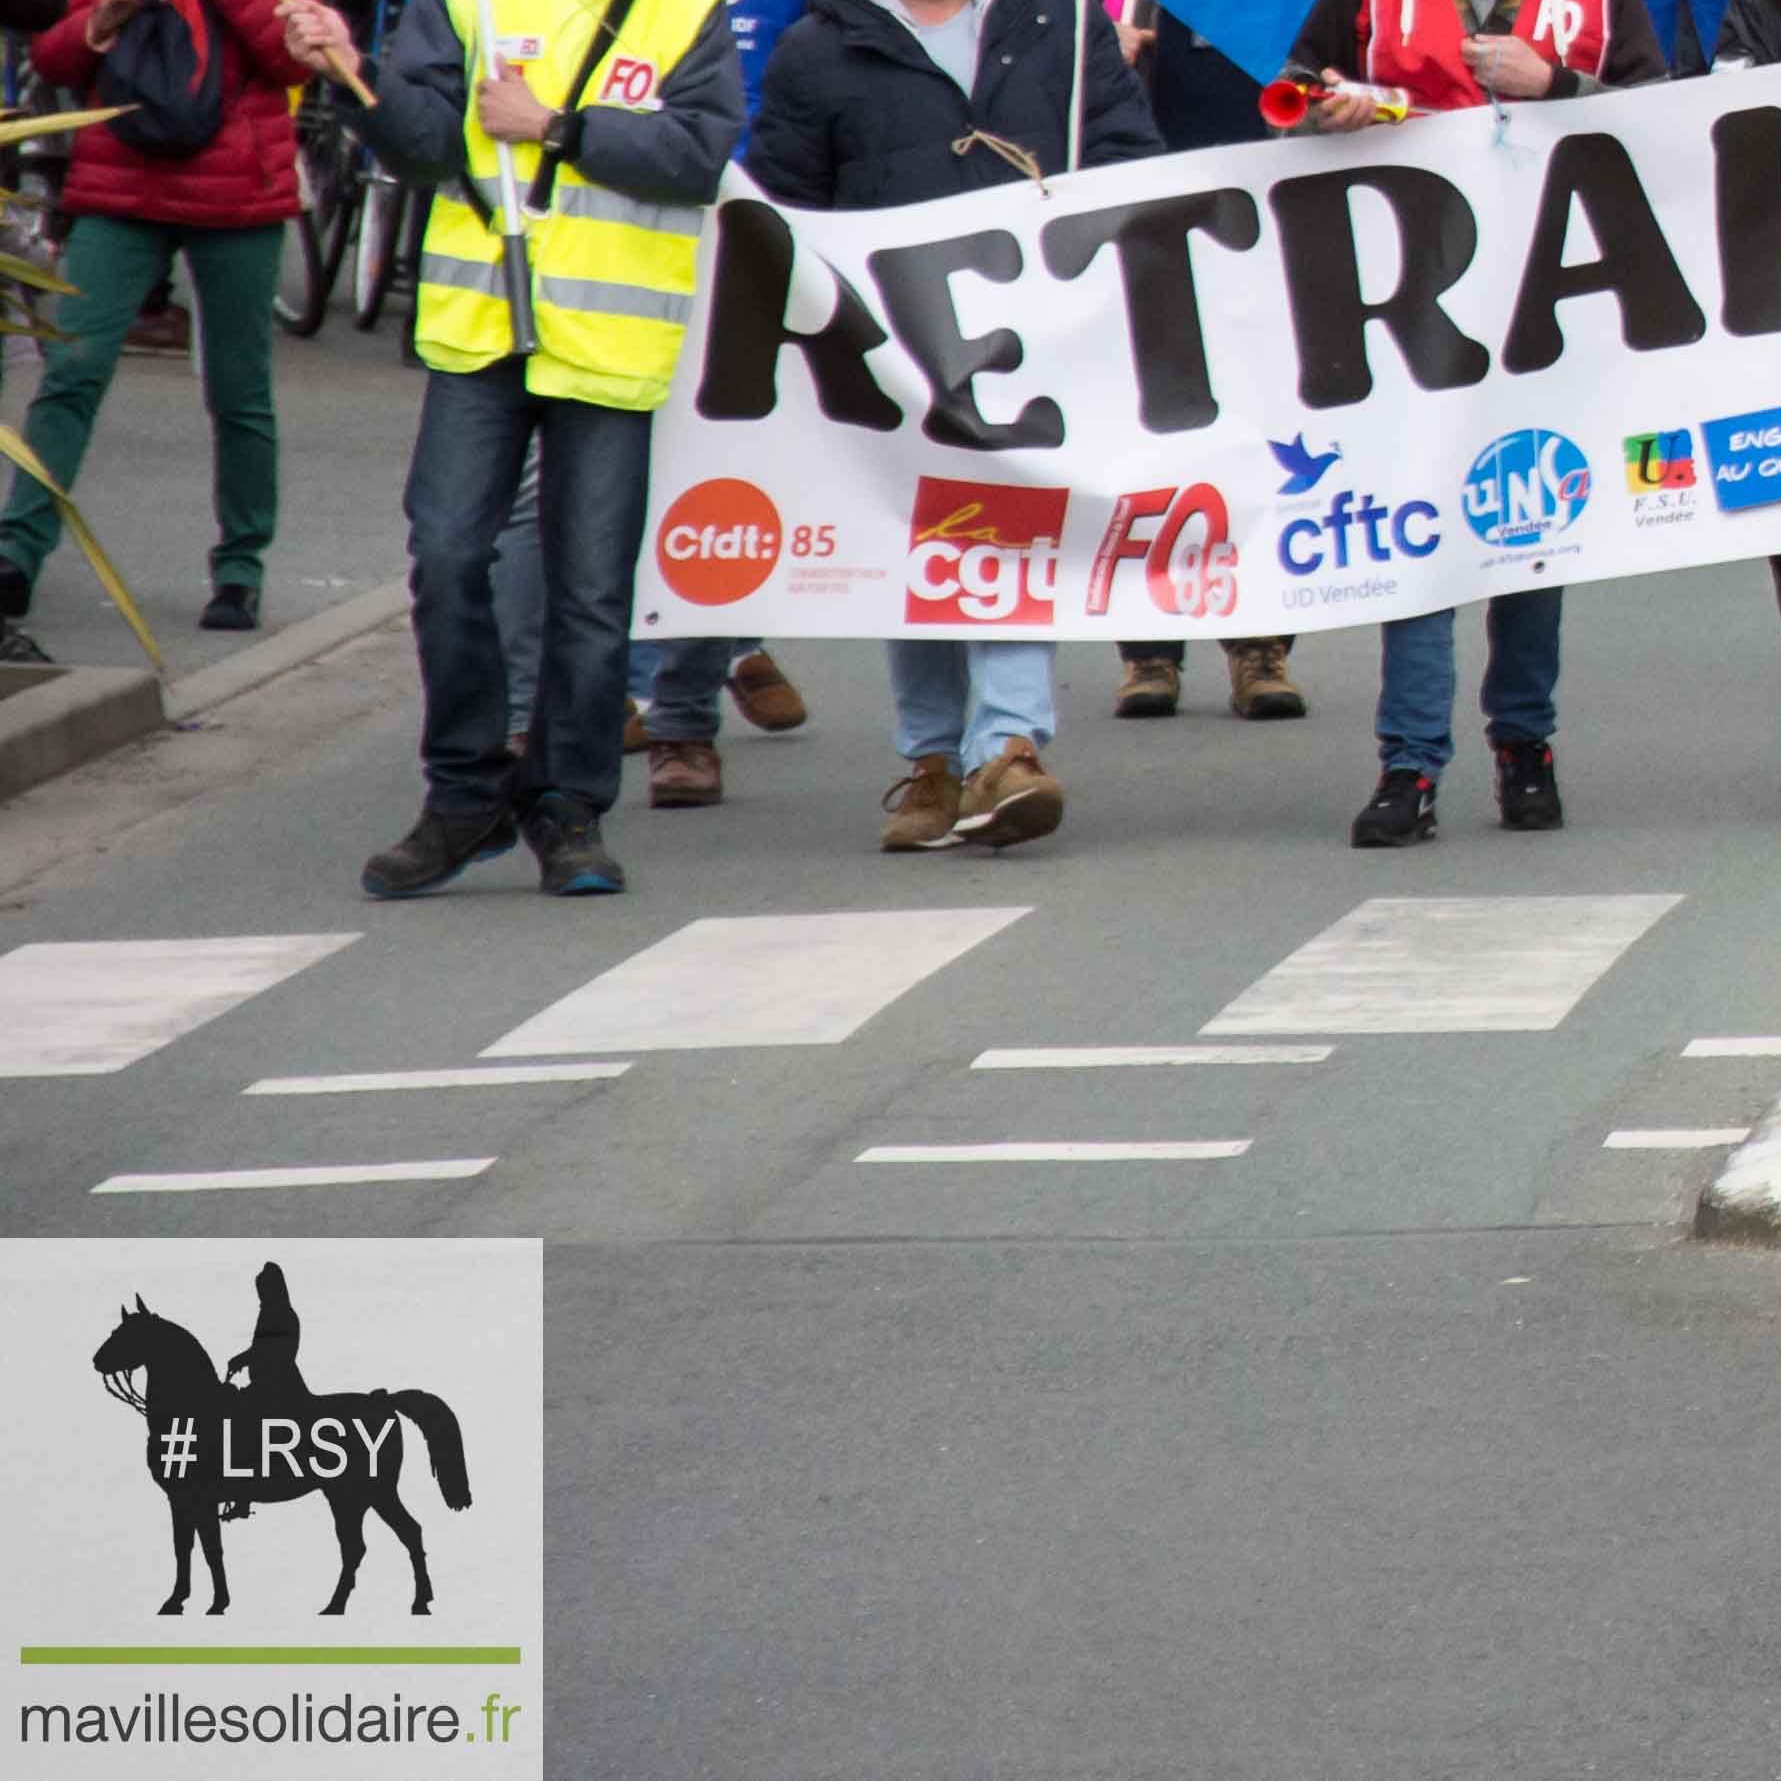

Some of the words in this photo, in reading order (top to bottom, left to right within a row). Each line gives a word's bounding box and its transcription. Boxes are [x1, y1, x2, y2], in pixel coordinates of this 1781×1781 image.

[602, 57, 655, 105] FO
[1716, 459, 1750, 483] AU
[790, 524, 837, 558] 85
[1085, 482, 1229, 616] FO
[1169, 541, 1239, 618] 85
[1277, 489, 1441, 578] cftc
[906, 535, 1057, 620] cgt
[1281, 587, 1313, 609] UD
[1318, 577, 1398, 604] Vendée
